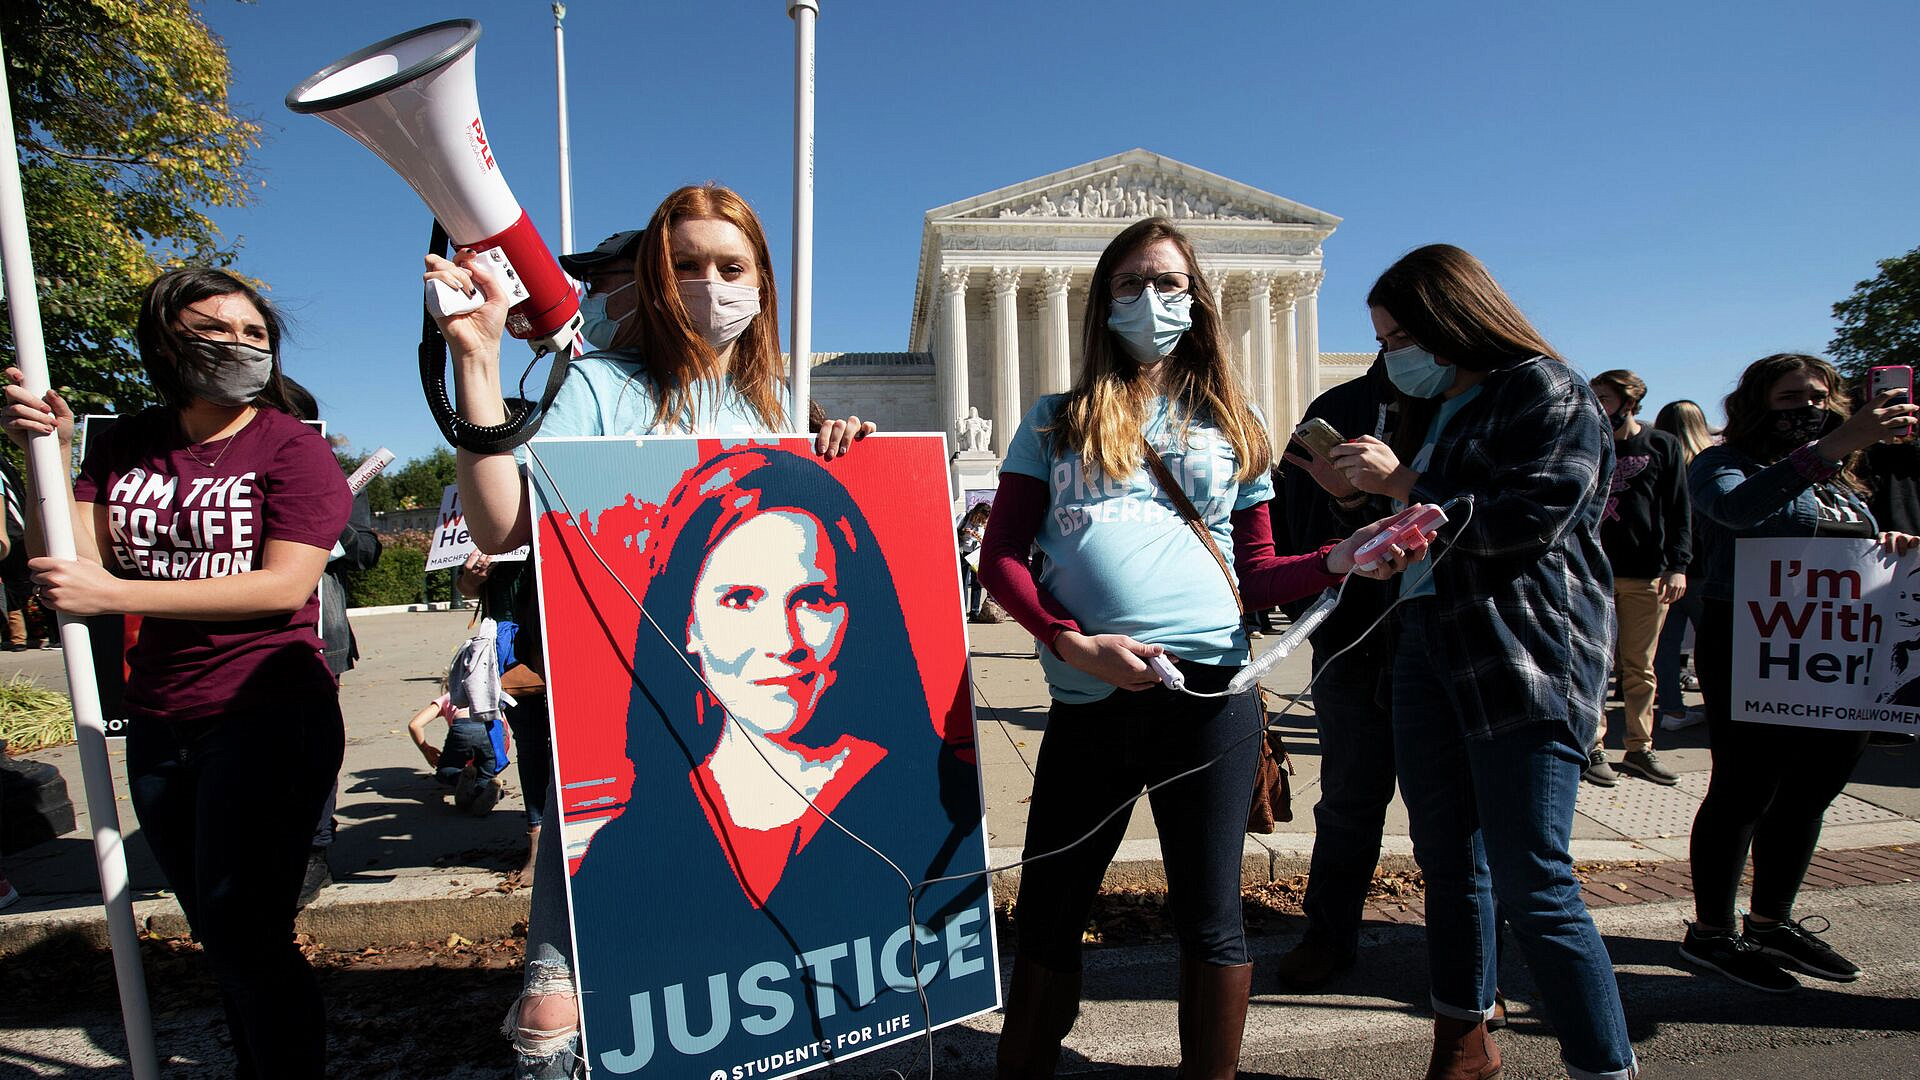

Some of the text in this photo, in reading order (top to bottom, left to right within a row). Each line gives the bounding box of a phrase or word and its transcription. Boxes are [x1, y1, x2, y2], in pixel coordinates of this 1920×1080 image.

[109, 467, 256, 509] AM THE
[351, 460, 386, 492] Indepen
[108, 505, 253, 549] RO-LIFE
[1769, 559, 1861, 600] I'm
[1747, 600, 1883, 644] With
[1758, 641, 1874, 686] Her!
[600, 906, 985, 1075] JUSTICE
[731, 1013, 911, 1080] STUDENTS FOR LIFE
